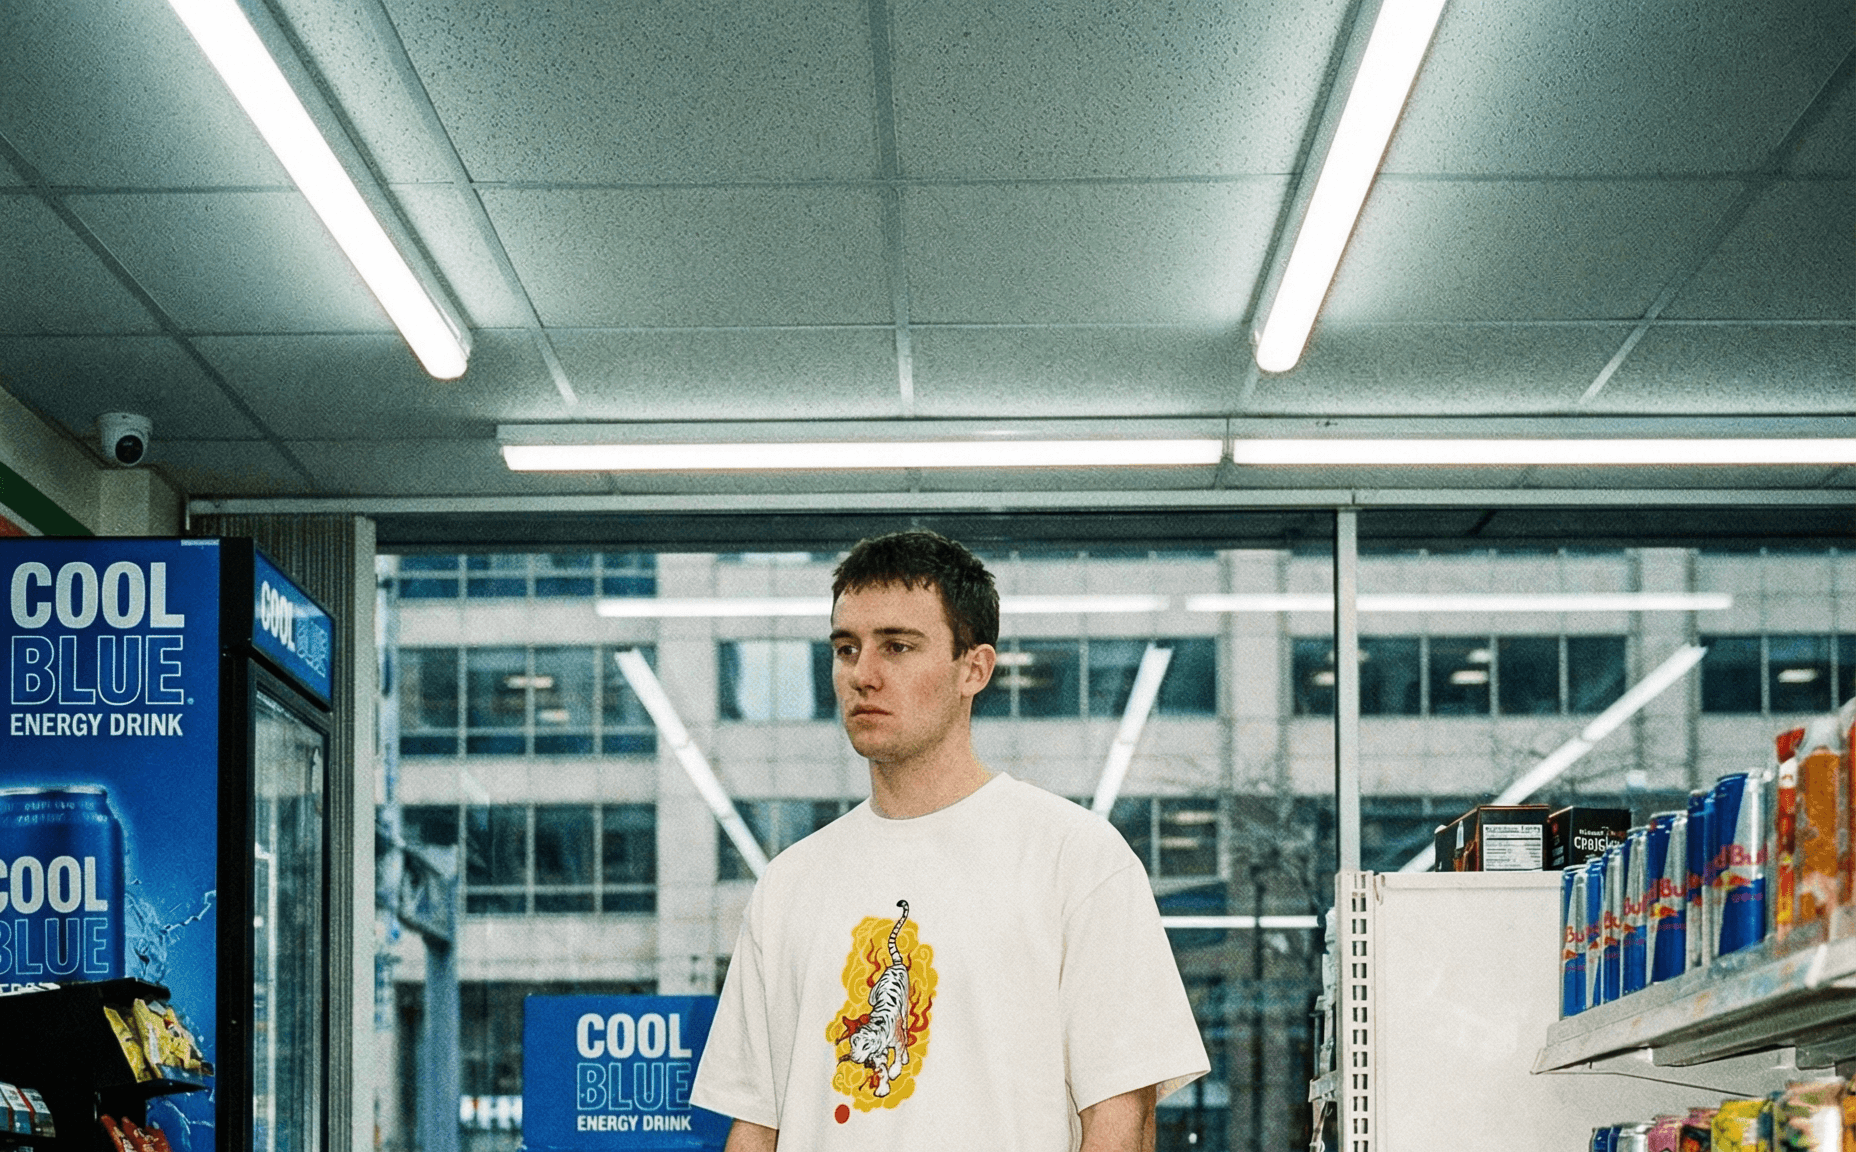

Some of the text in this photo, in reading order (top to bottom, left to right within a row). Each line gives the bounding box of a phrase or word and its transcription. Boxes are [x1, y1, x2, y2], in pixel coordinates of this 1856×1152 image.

[10, 561, 185, 629] COOL
[261, 580, 296, 653] COOL
[10, 634, 185, 706] BLUE
[9, 712, 184, 737] ENERGY DRINK
[0, 855, 109, 915] OOL
[576, 1013, 692, 1059] COOL
[576, 1062, 692, 1111] BLUE
[577, 1115, 692, 1132] ENERGY DRINK
